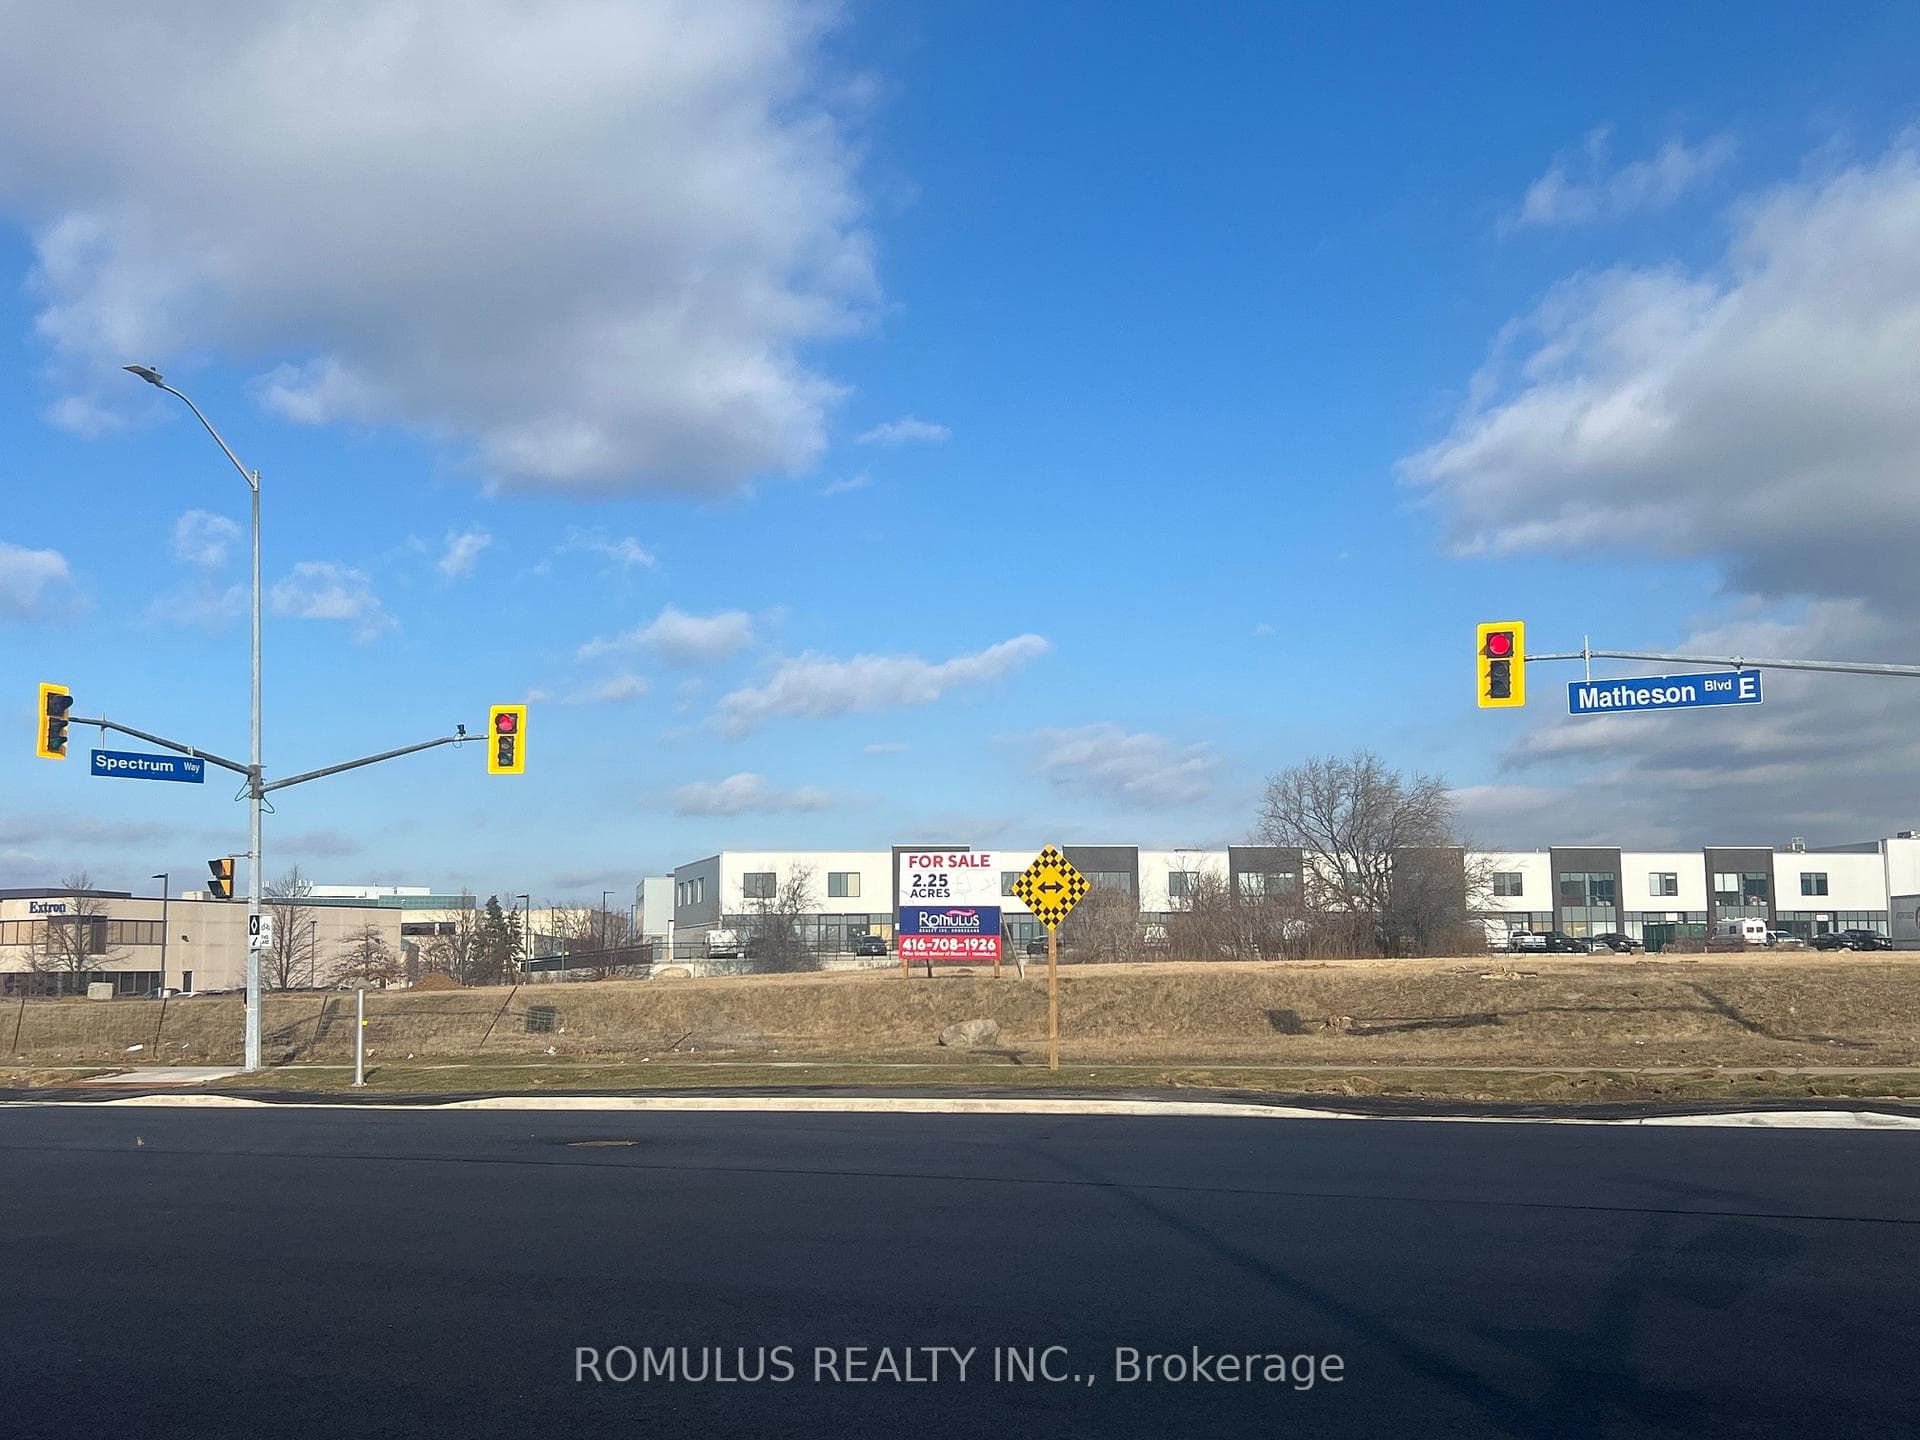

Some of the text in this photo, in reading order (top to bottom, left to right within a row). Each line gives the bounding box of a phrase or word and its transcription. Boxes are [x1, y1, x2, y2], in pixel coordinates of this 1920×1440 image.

[1578, 677, 1756, 709] Matheson Blvd E
[95, 754, 200, 774] Spectrum Way
[908, 854, 991, 868] FOR SALE
[912, 873, 948, 888] 2.25
[910, 888, 951, 898] ACRES
[29, 901, 66, 913] Extron
[902, 938, 997, 951] 416-708-1926
